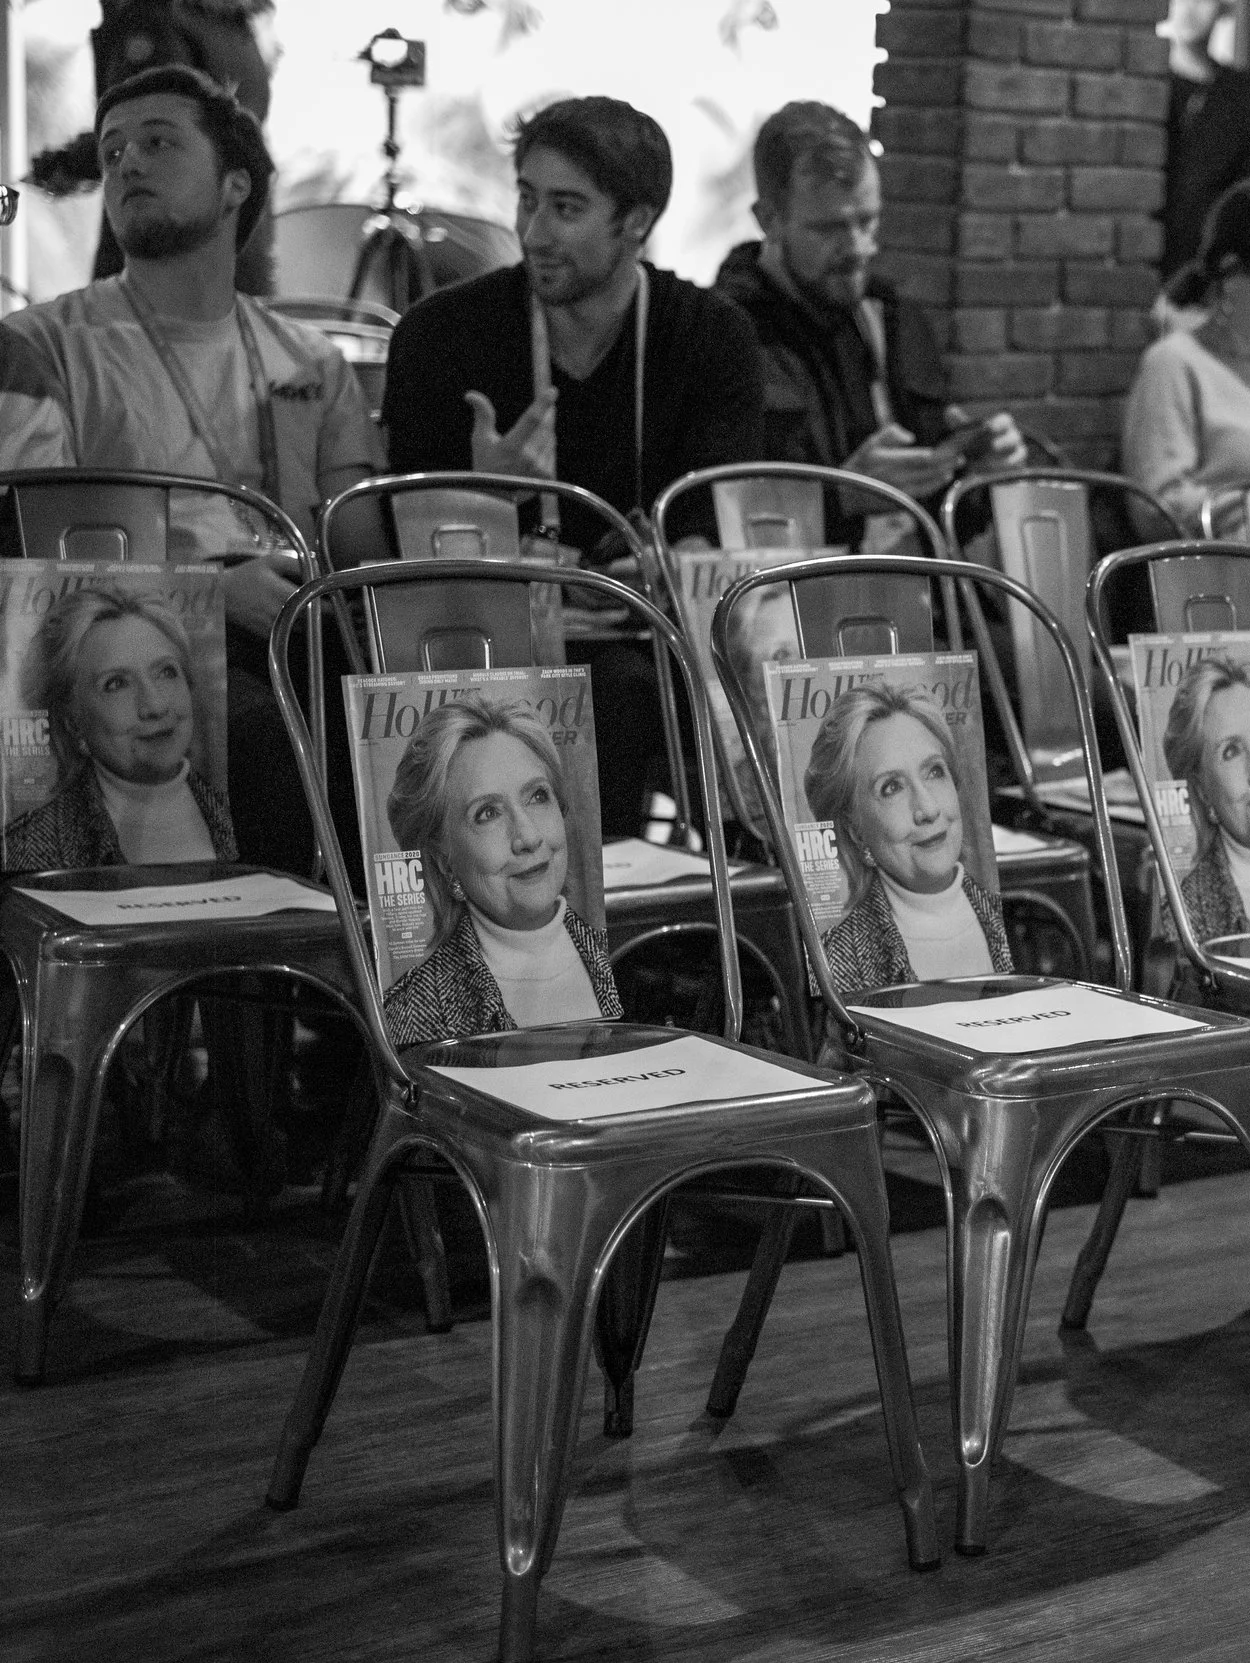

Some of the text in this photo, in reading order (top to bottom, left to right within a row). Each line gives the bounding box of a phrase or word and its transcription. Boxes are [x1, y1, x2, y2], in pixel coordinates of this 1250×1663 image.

[779, 667, 974, 721] Holod
[360, 682, 588, 740] Holod
[3, 718, 50, 746] HRC
[796, 829, 838, 862] HRC
[375, 859, 425, 895] HRC
[800, 858, 840, 873] THE SERIES
[379, 892, 426, 908] THE SERIES
[955, 1010, 1072, 1027] RESERVED
[548, 1068, 686, 1090] RESERVED
